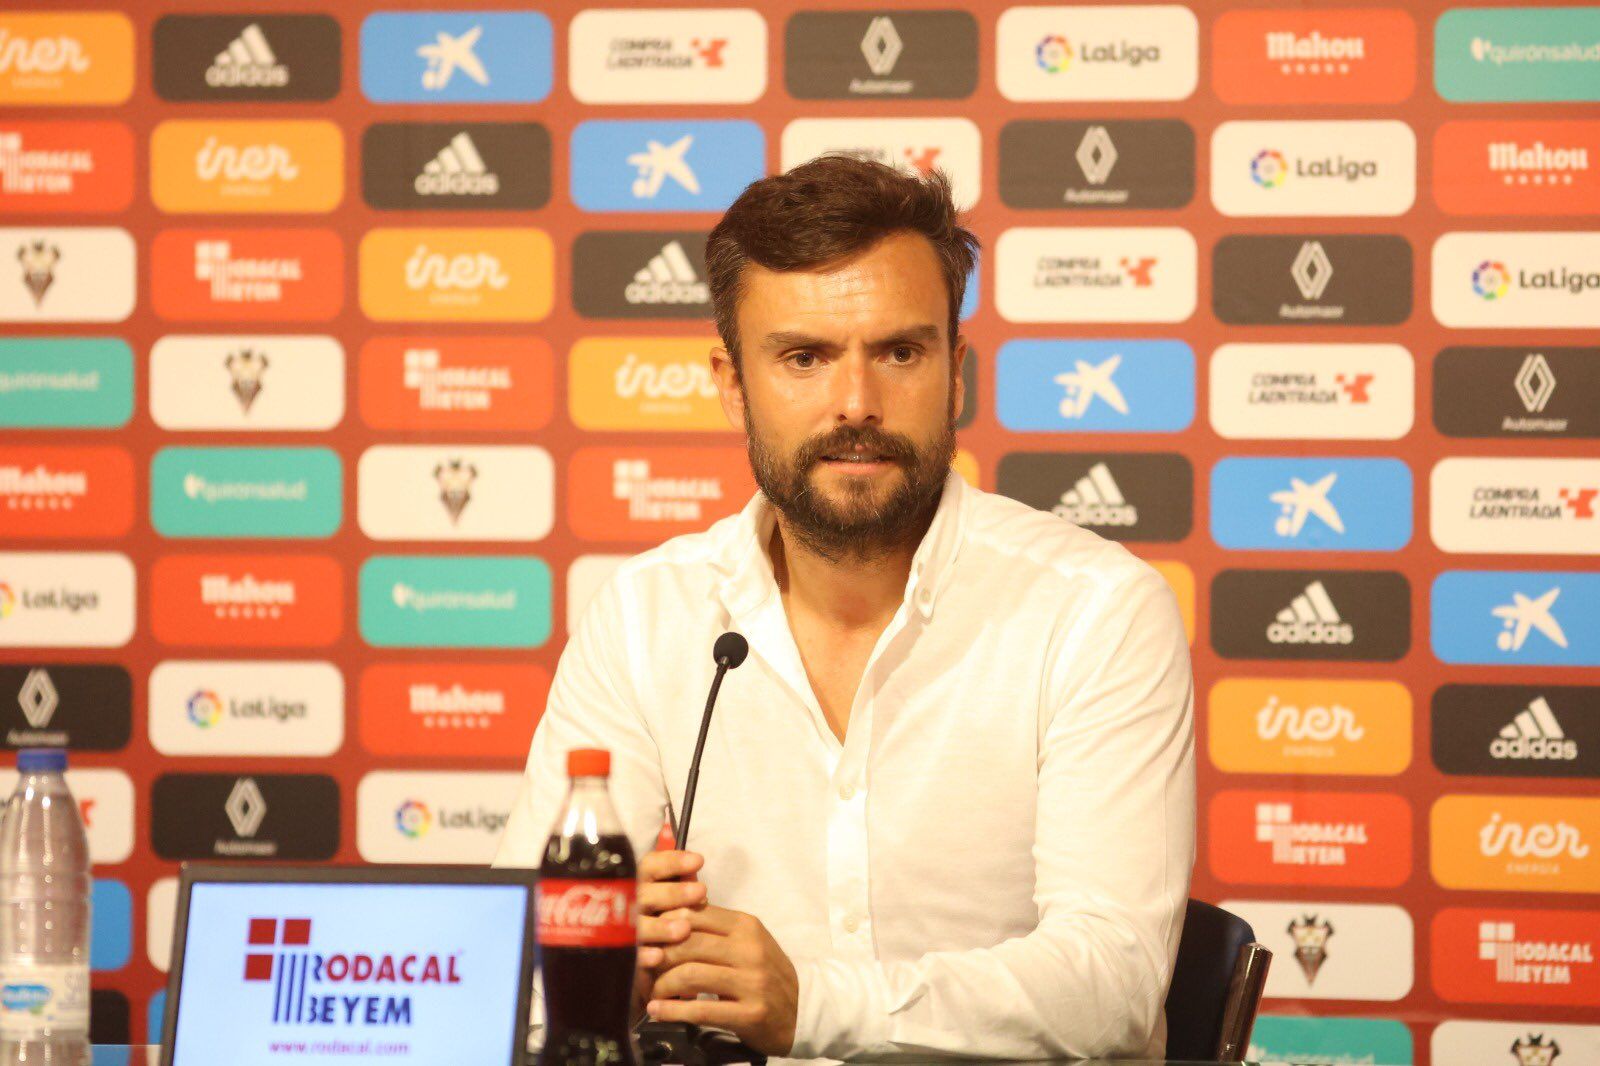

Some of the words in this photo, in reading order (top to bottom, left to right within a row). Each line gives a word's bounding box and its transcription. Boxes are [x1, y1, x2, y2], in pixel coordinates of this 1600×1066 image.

[1080, 42, 1160, 66] LaLiga
[1266, 31, 1365, 60] Mahou
[205, 64, 290, 87] adidas
[1296, 156, 1378, 181] LaLiga
[1488, 142, 1588, 171] Mahou
[414, 172, 499, 195] adidas
[625, 281, 711, 304] adidas
[1519, 267, 1600, 294] LaLiga
[1251, 374, 1317, 387] COMPRA
[1473, 487, 1540, 501] COMPRA
[1470, 504, 1562, 519] LAENTRADA
[22, 587, 99, 613] LaLiga
[200, 574, 295, 604] Mahou
[1266, 622, 1354, 645] adidas
[229, 696, 307, 722] LaLiga
[410, 684, 504, 714] Mahou
[1489, 737, 1578, 760] adidas
[1479, 813, 1590, 859] iner
